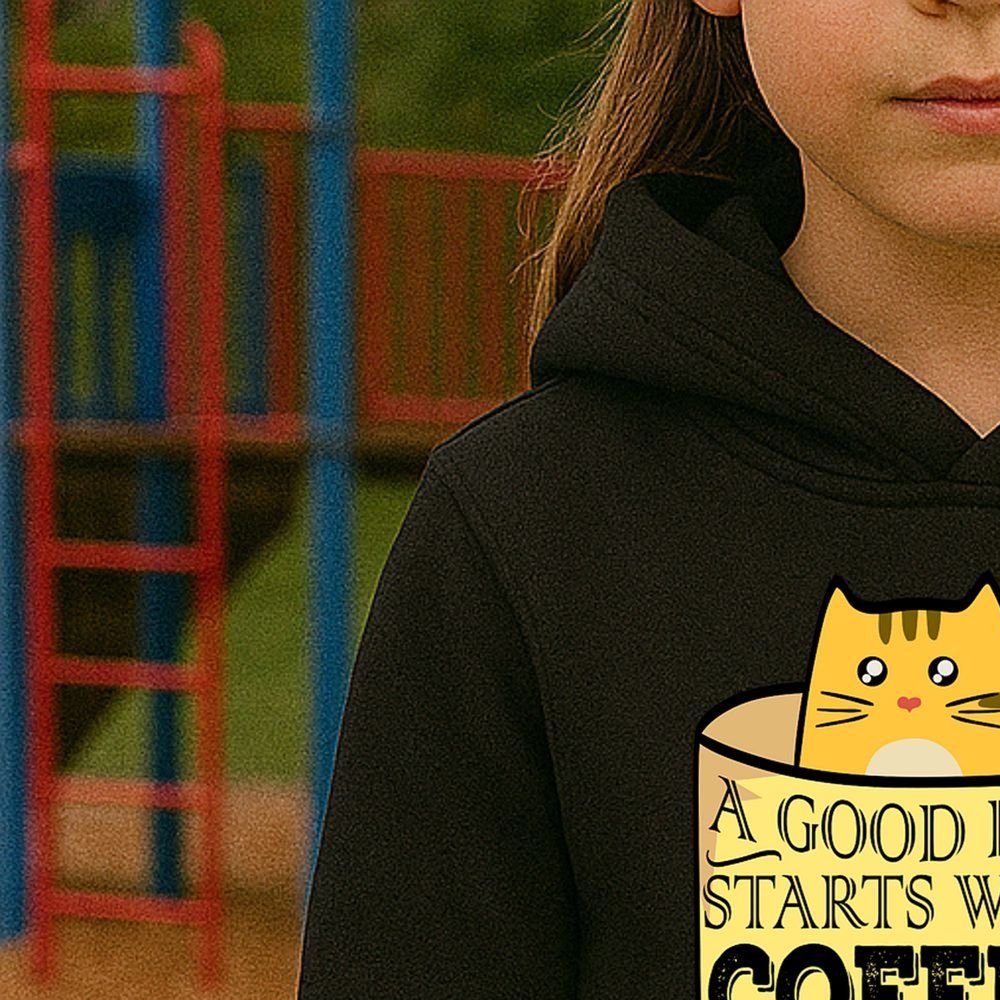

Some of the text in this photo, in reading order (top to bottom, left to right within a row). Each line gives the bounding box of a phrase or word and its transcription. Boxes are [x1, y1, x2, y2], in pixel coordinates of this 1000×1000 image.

[708, 775, 757, 843] A
[777, 793, 966, 863] GOOD
[703, 874, 935, 930] STARTS
